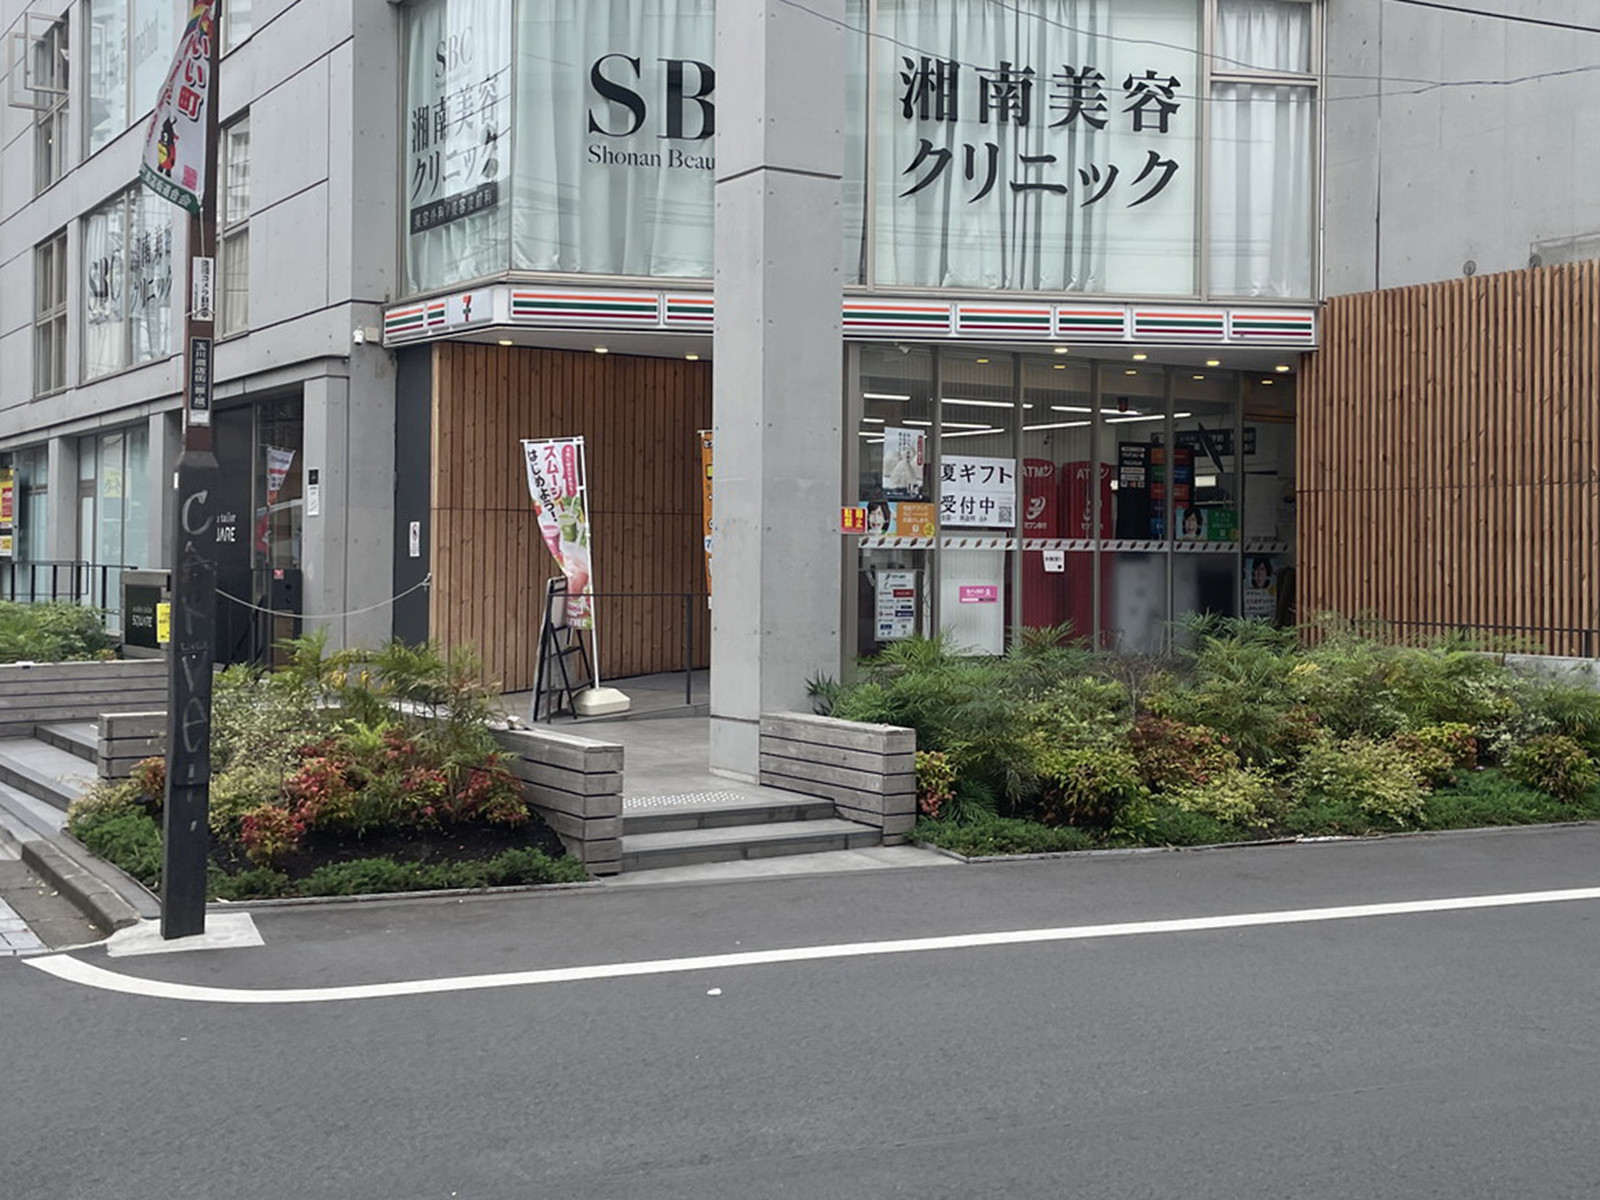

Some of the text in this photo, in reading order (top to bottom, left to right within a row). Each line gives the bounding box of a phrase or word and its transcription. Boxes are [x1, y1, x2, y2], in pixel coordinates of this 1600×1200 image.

[411, 74, 499, 153] 湘南美容
[898, 56, 1182, 134] 湘南美容
[411, 132, 499, 202] クリニック
[587, 144, 662, 168] Shonan
[898, 137, 1180, 208] クリニック
[543, 445, 565, 513] スムージー
[940, 494, 995, 516] 受付中
[941, 463, 1013, 484] 夏ギフト
